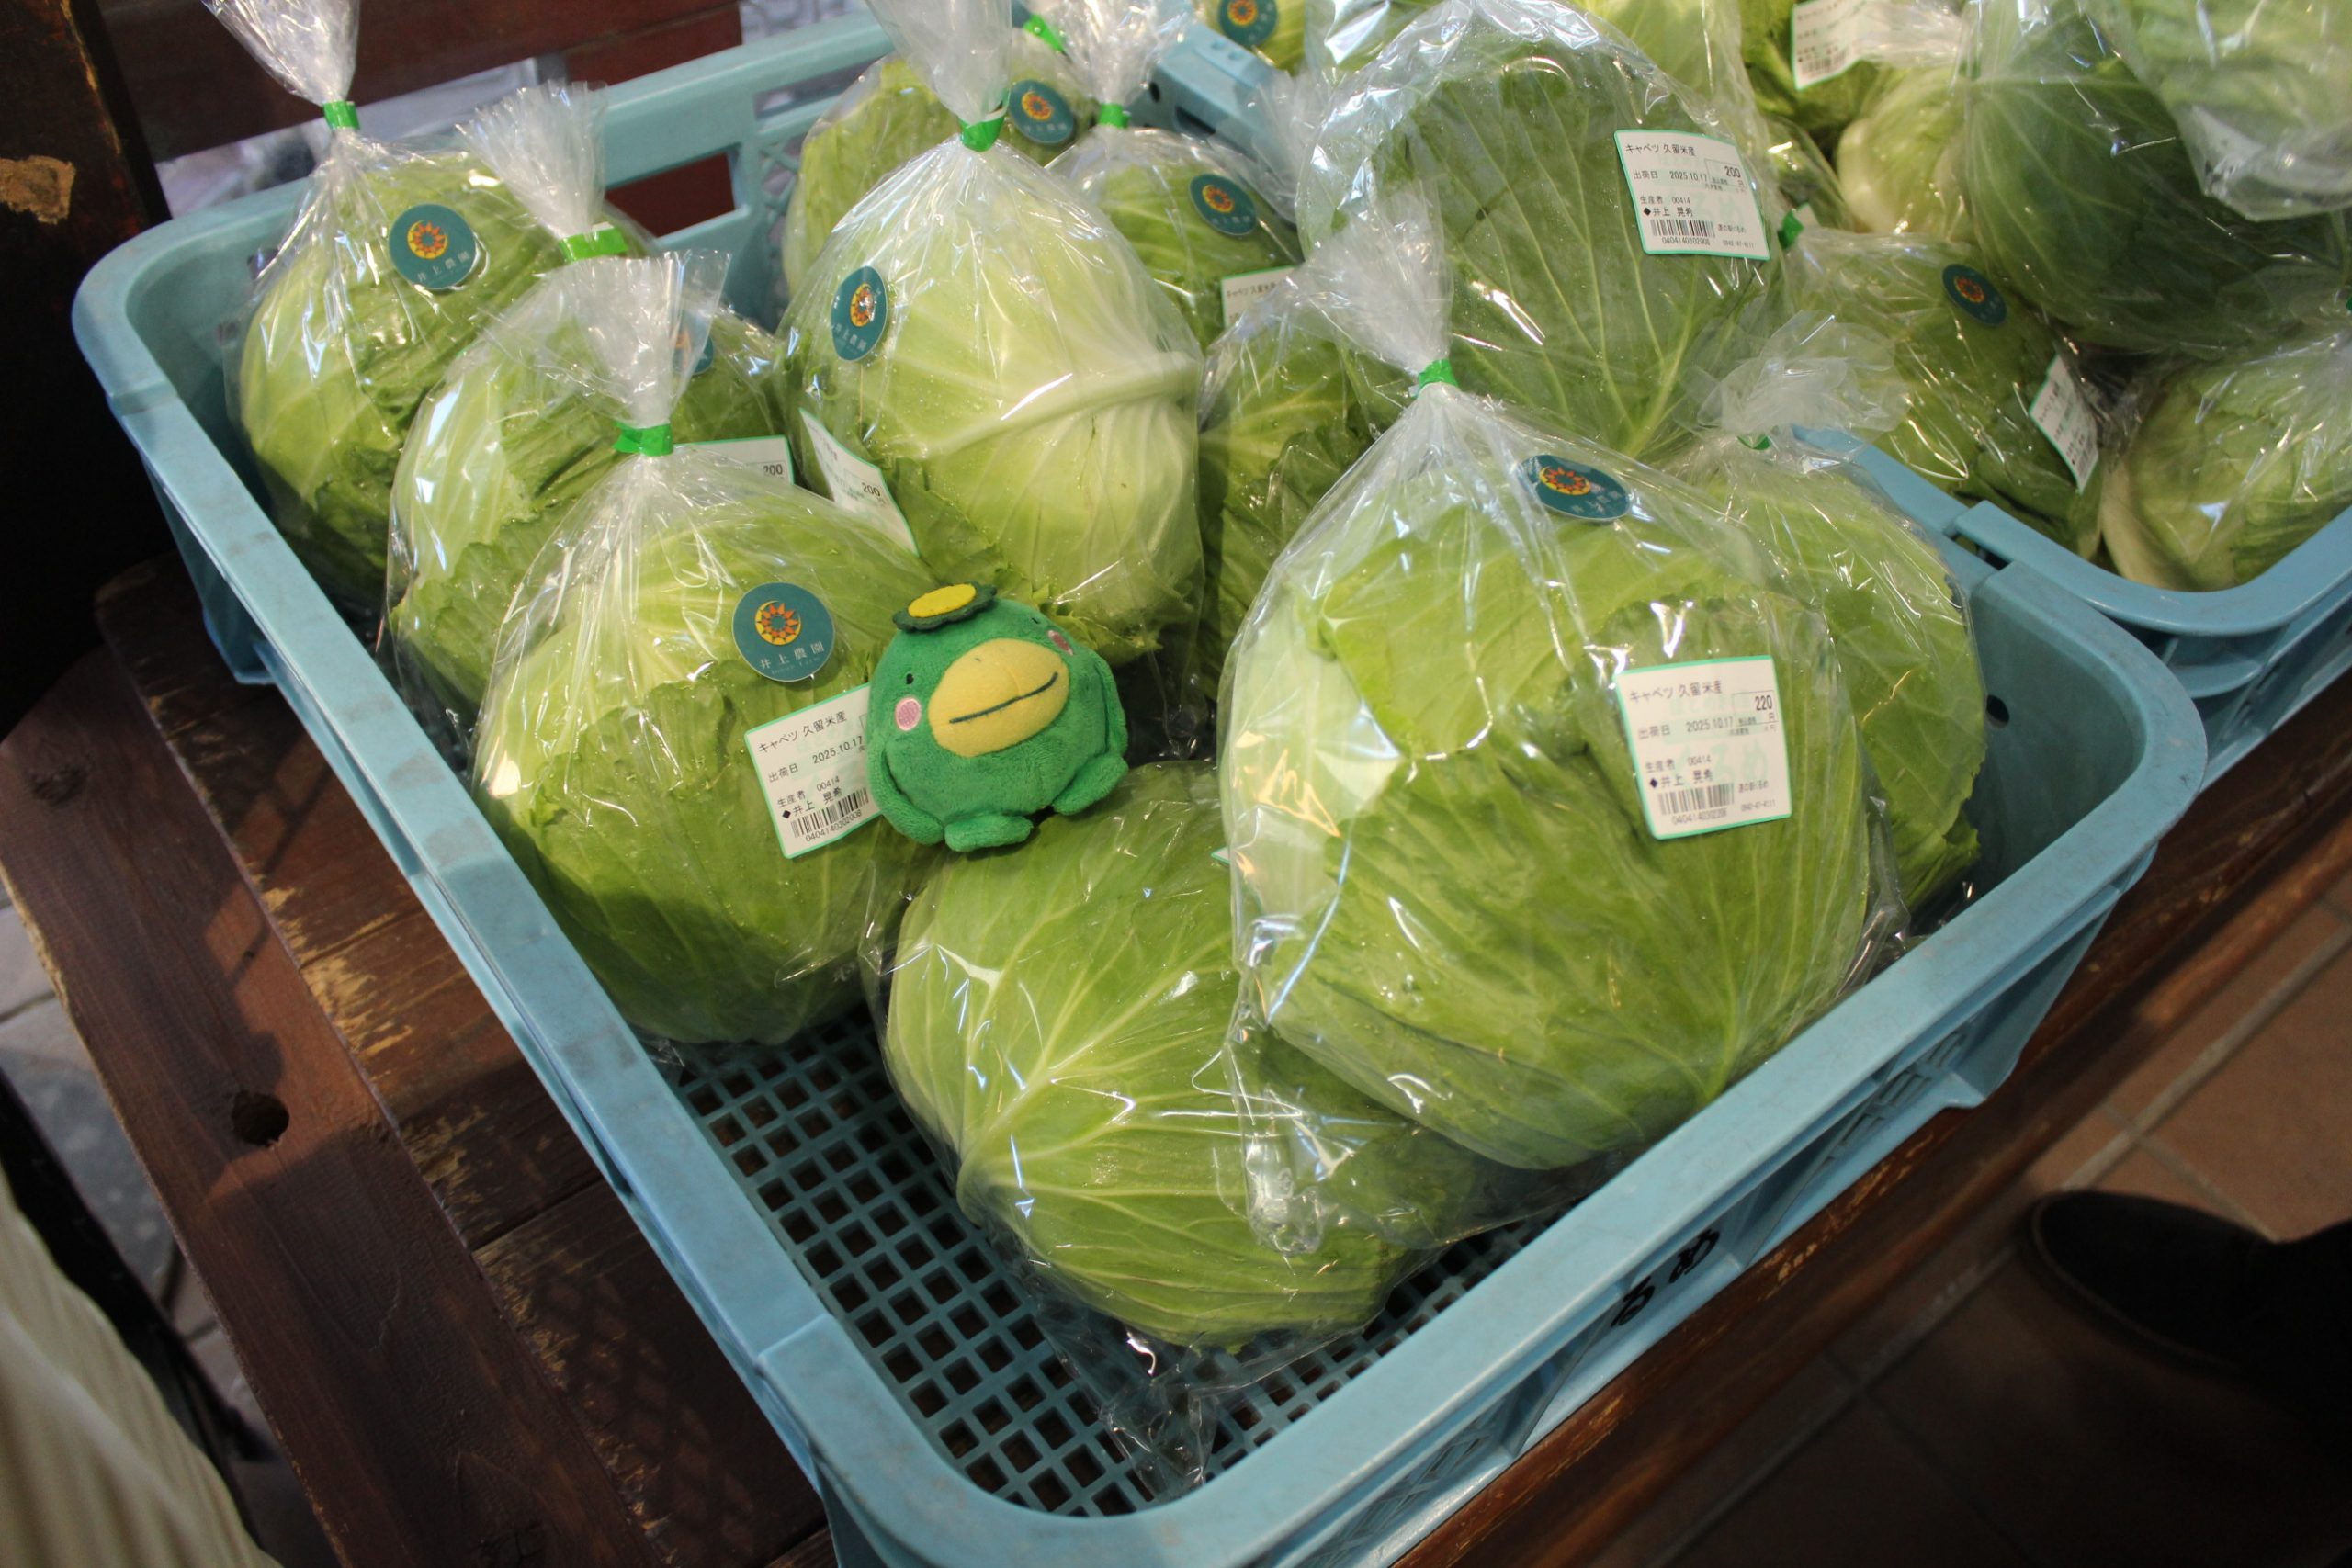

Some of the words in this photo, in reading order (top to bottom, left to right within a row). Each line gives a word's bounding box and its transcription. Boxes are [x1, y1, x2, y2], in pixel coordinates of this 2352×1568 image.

[1625, 144, 1659, 155] キャベツ
[1663, 144, 1697, 157] 久留米産
[1633, 170, 1659, 180] 出荷日
[1669, 170, 1708, 183] 2025.10.17
[1724, 165, 1742, 178] 200
[861, 481, 881, 497] 200
[759, 640, 825, 671] 井上農園
[1630, 685, 1674, 703] キャベツ
[1754, 694, 1773, 712] 220
[758, 730, 799, 754] キャベツ
[802, 710, 847, 737] 久留米産
[768, 763, 799, 784] 出荷日
[812, 735, 864, 765] 2025.10.17
